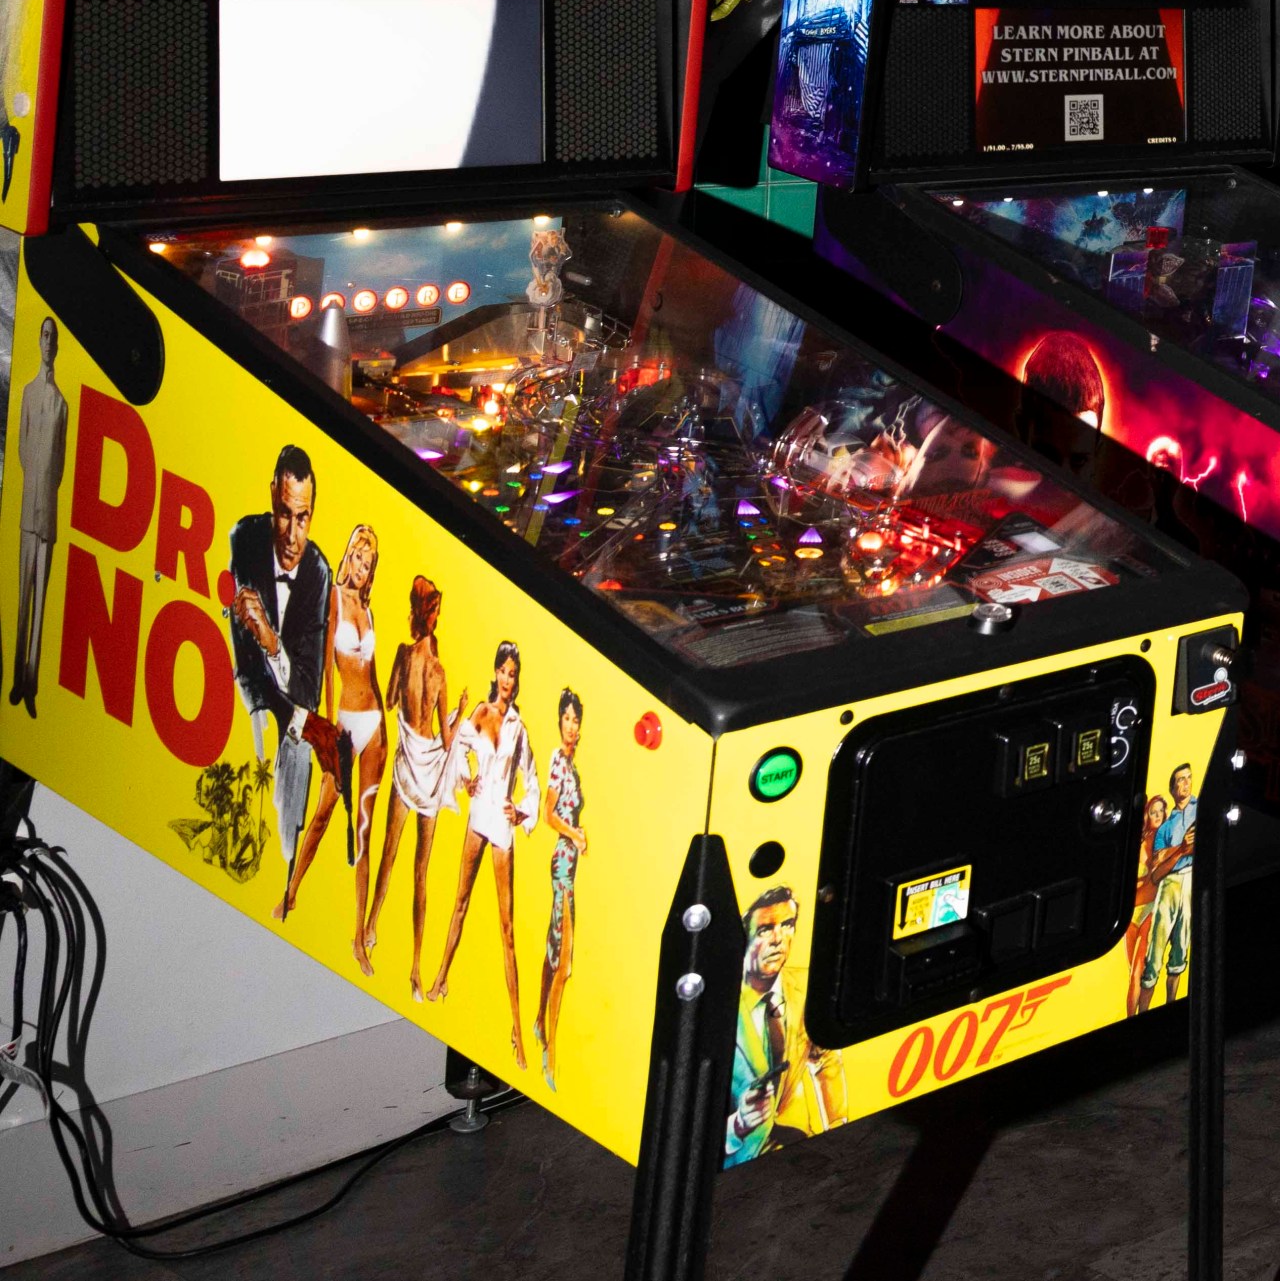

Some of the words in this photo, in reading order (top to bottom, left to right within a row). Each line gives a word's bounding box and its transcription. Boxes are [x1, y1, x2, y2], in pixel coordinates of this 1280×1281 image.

[993, 25, 1052, 40] LEARN
[1057, 25, 1105, 40] MORE
[1110, 24, 1166, 39] ABOUT
[1001, 48, 1058, 63] STERN
[1063, 47, 1134, 62] PINBALL
[1138, 46, 1159, 60] AT
[981, 67, 1177, 83] WWW.STERNPINBALL.COM
[70, 383, 236, 607] DR.
[58, 542, 236, 768] NO
[761, 768, 794, 785] START
[906, 882, 929, 896] INSERT
[930, 879, 942, 889] BILL
[943, 873, 960, 884] HERE
[888, 992, 1024, 1098] 007
